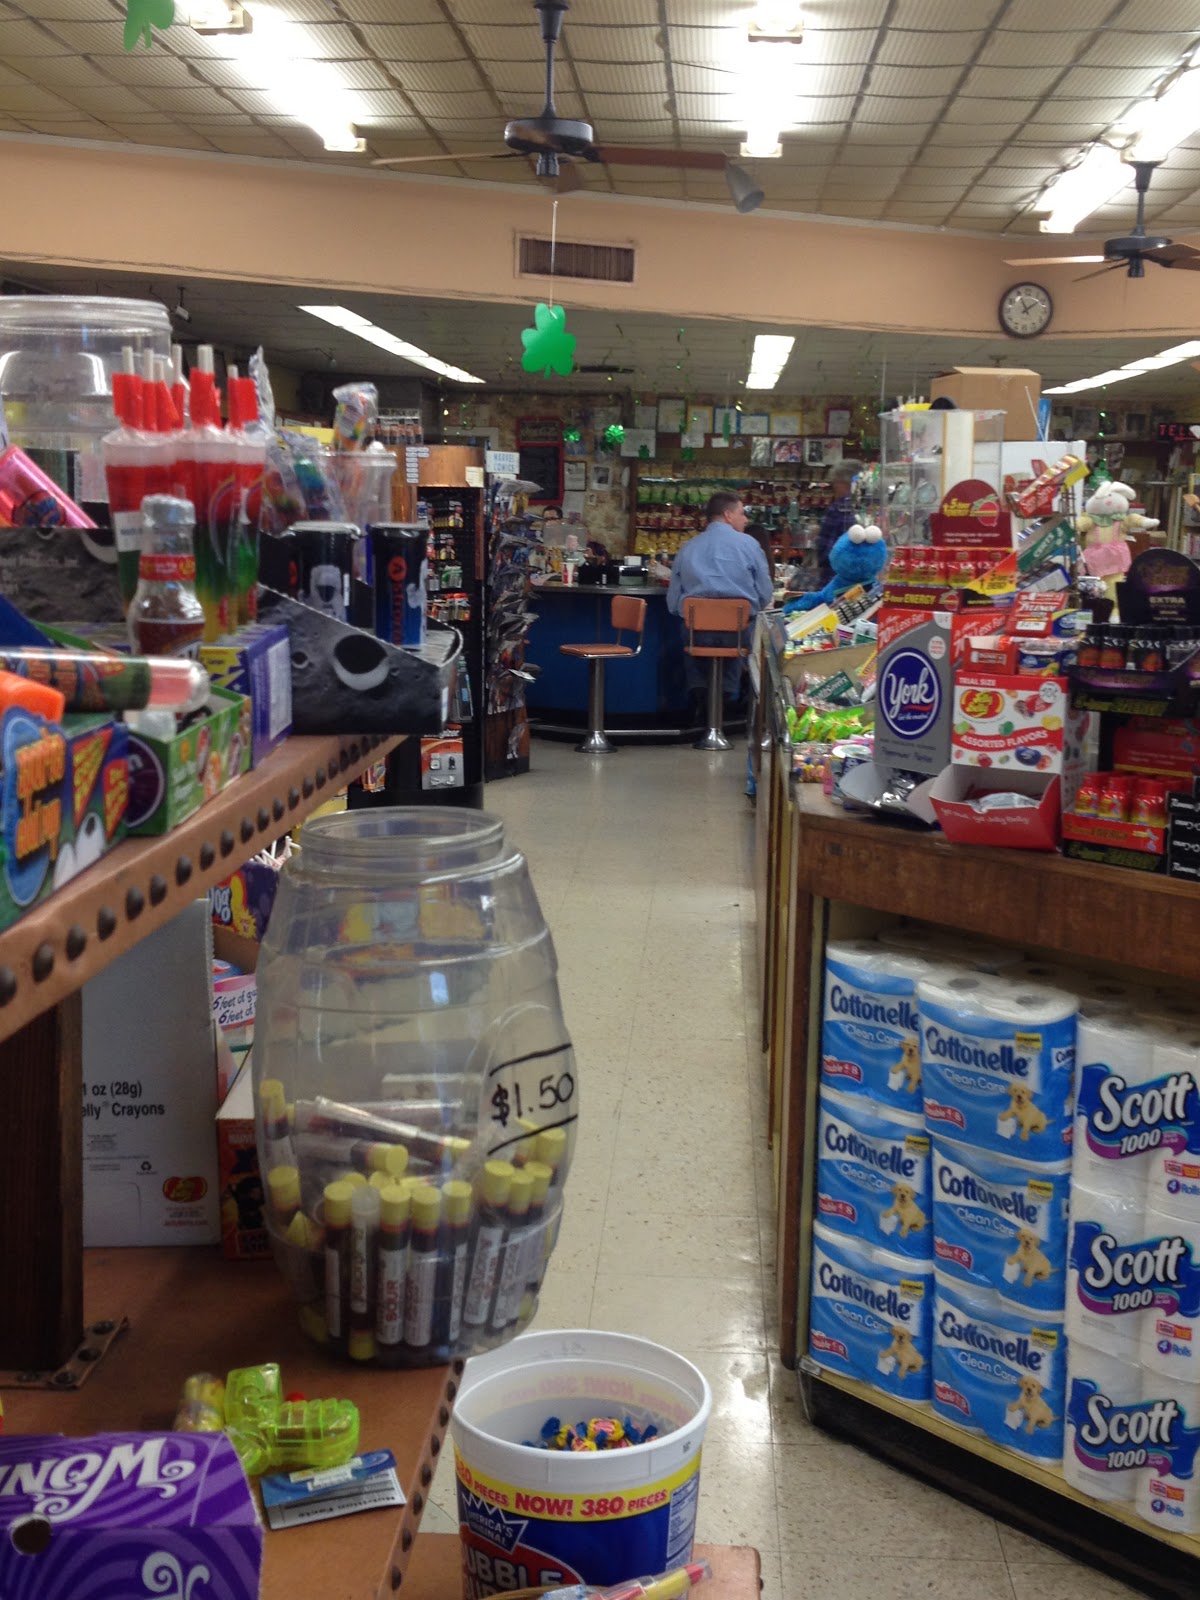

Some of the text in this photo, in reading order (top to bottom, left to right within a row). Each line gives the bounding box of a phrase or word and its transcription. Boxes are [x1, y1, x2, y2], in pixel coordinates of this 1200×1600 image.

[887, 667, 936, 719] York
[959, 677, 997, 687] TRIAL SIZE
[960, 730, 1049, 748] ASSORTED FLAVORS
[218, 1009, 229, 1025] 6
[227, 1009, 244, 1024] feet
[219, 996, 236, 1011] feet
[237, 989, 246, 1003] of
[830, 984, 920, 1032] Cottonelle
[925, 1026, 1029, 1077] Cottonelle
[81, 1101, 165, 1119] elly Crayons
[91, 1085, 107, 1097] oz
[110, 1080, 142, 1099] (28g)
[491, 1071, 575, 1127] $1.50
[1093, 1072, 1195, 1133] Scott
[825, 1122, 916, 1178] Cottonelle
[1120, 1128, 1162, 1155] 1000
[938, 1165, 1038, 1225] Cottonelle
[1084, 1233, 1186, 1289] Scott
[819, 1262, 912, 1321] Cottonelle
[1112, 1288, 1154, 1311] 1000
[938, 1311, 1042, 1371] Cottonelle
[958, 1351, 992, 1373] Clean
[1081, 1394, 1179, 1445] Scott
[0, 1437, 196, 1524] WON
[1107, 1448, 1148, 1469] 1000
[474, 1480, 509, 1507] PIECES
[515, 1492, 574, 1517] NOW!
[580, 1496, 624, 1518] 380
[628, 1489, 668, 1512] PIECES
